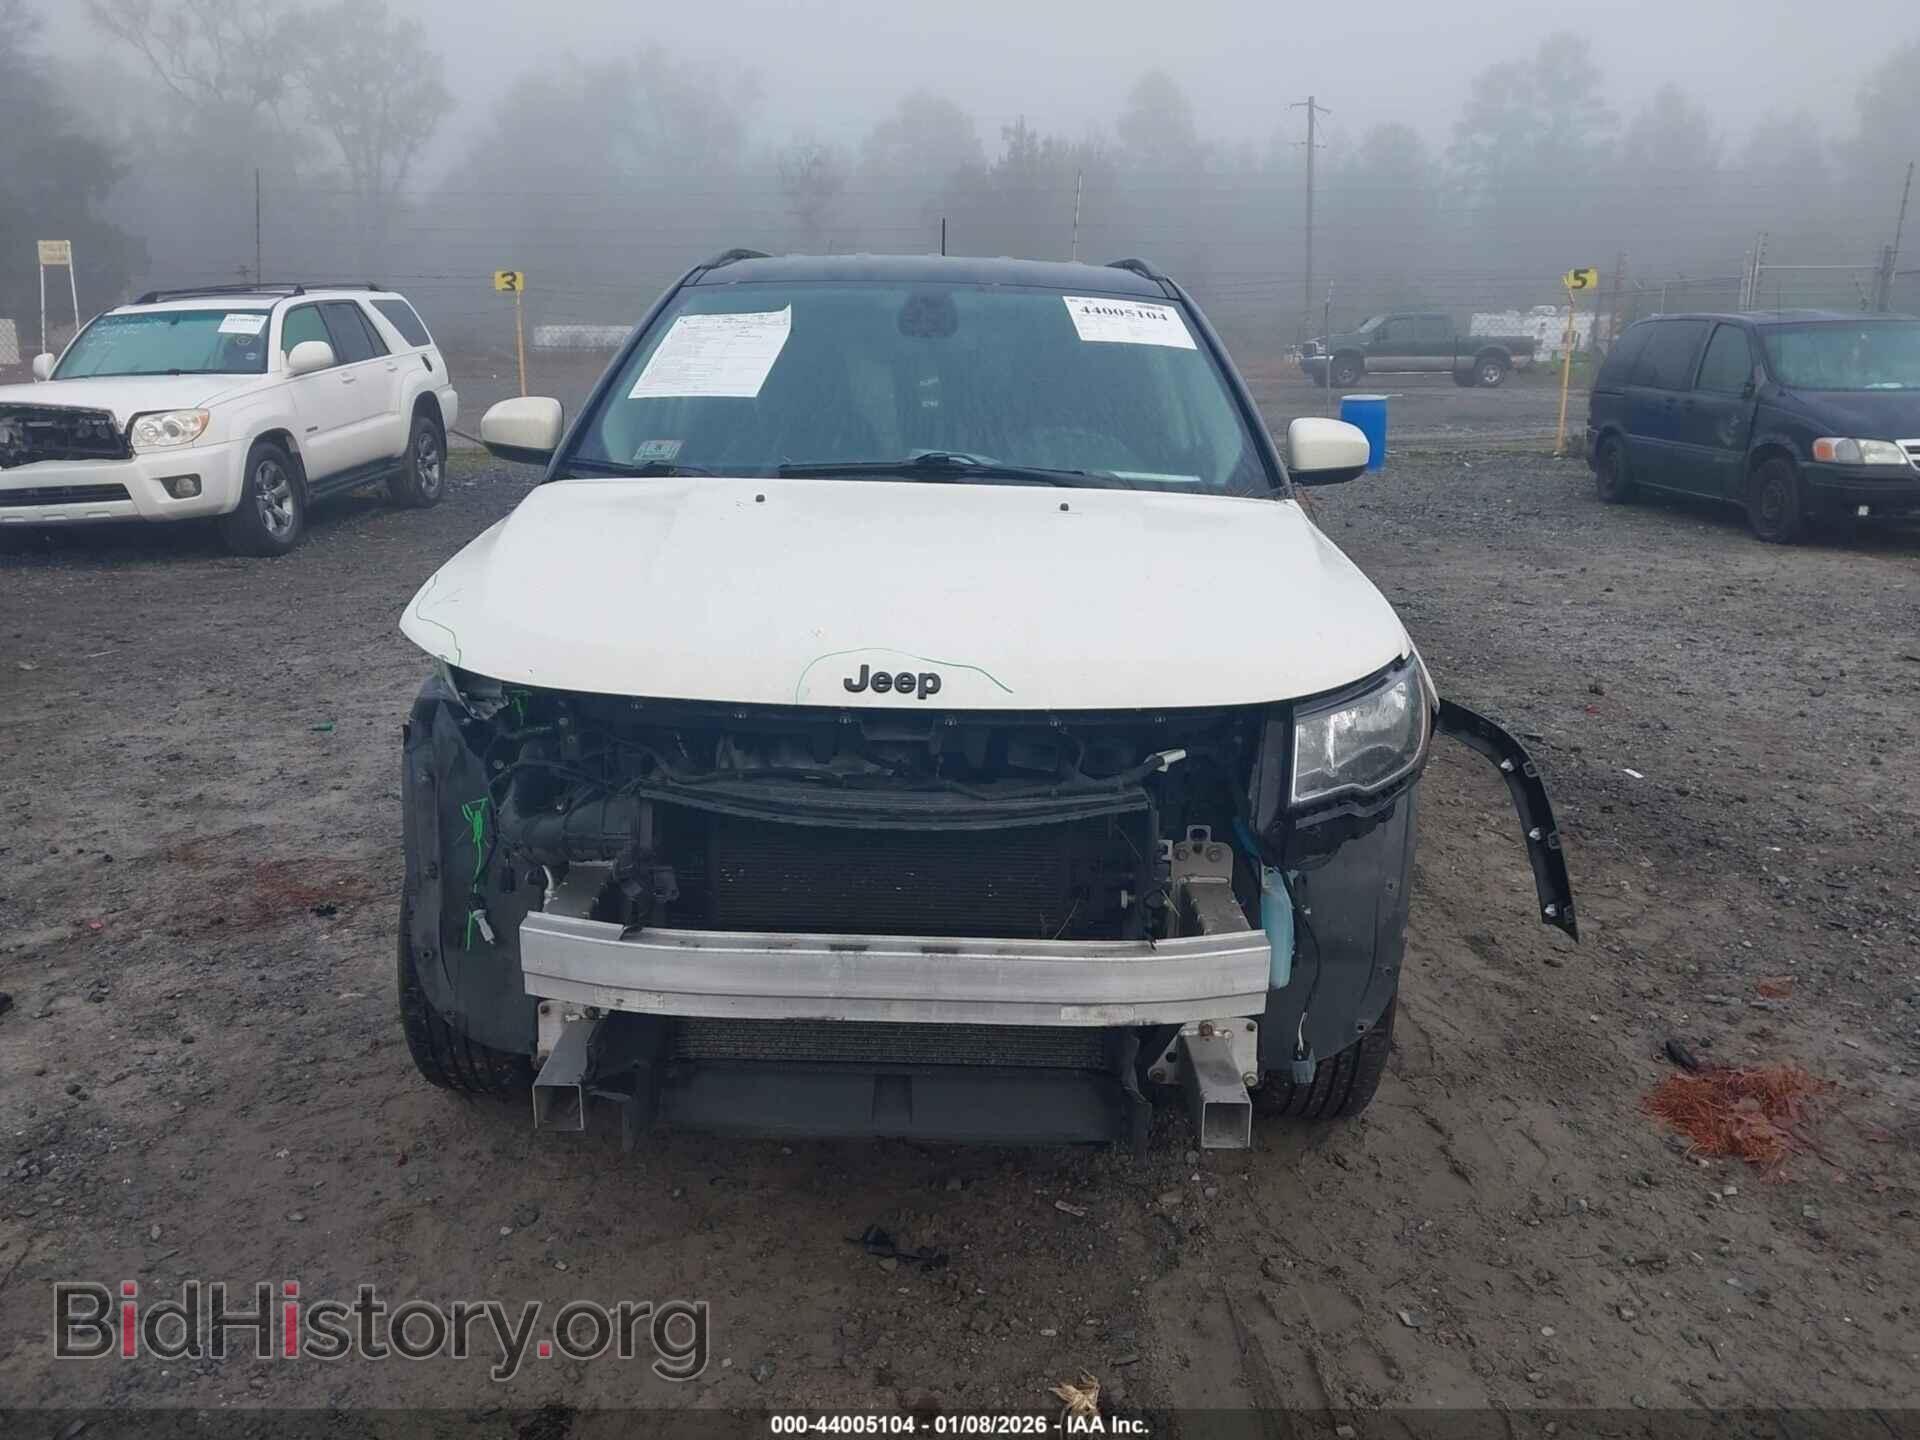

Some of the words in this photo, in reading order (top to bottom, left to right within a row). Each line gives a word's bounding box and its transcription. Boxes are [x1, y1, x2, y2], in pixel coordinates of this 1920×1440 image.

[501, 271, 517, 291] 3
[1571, 269, 1588, 289] 5
[1081, 305, 1168, 321] 44005104
[843, 664, 942, 700] Jeep
